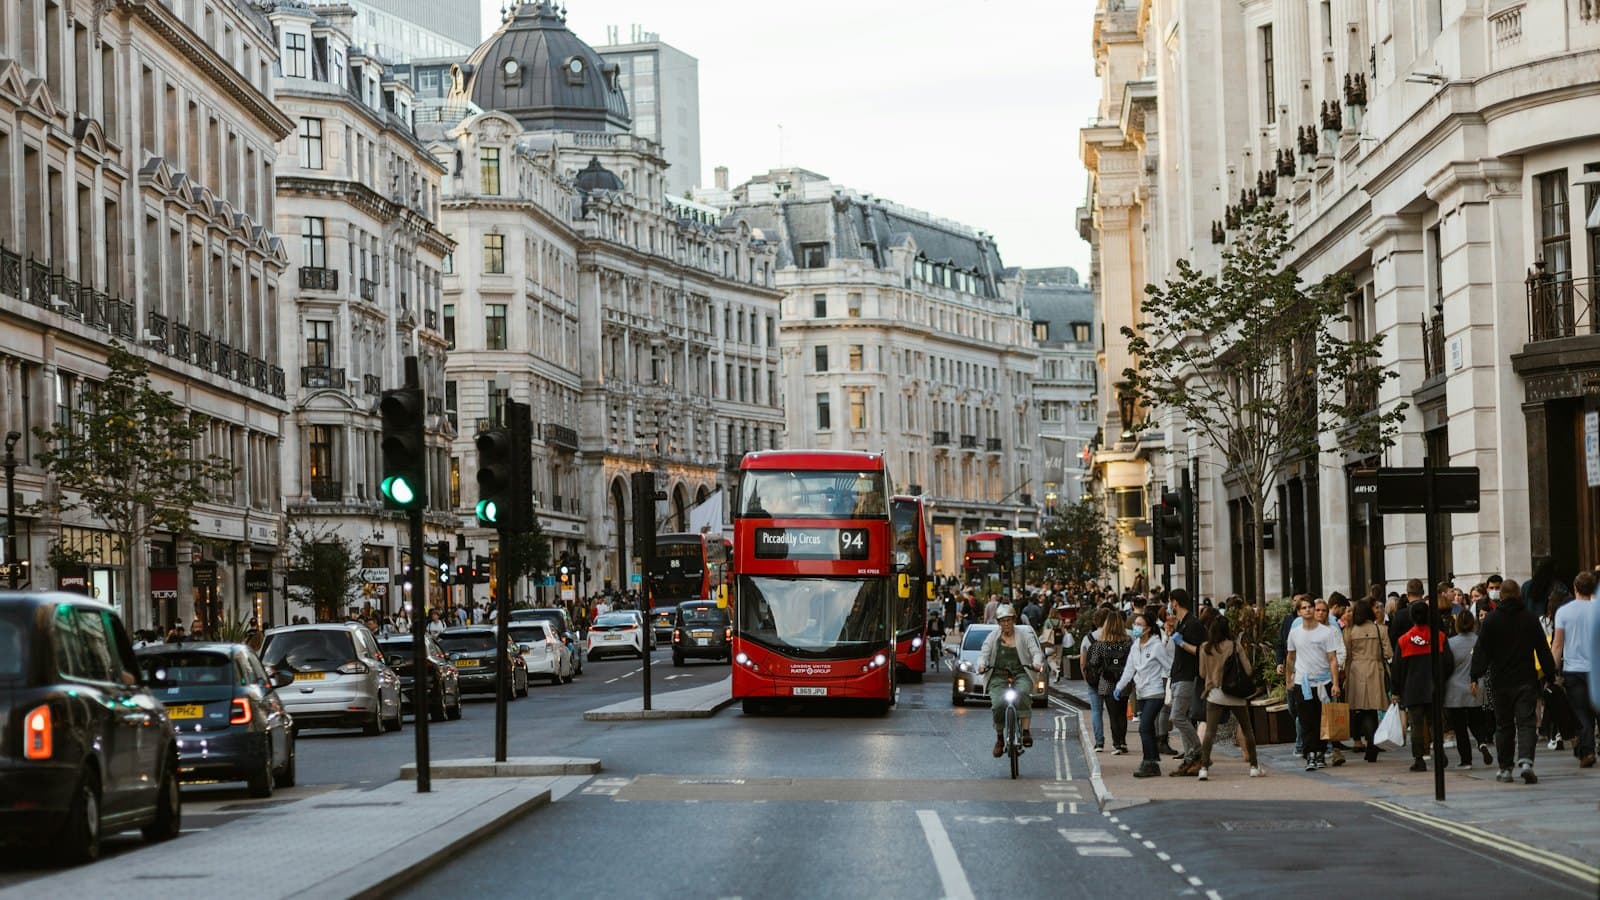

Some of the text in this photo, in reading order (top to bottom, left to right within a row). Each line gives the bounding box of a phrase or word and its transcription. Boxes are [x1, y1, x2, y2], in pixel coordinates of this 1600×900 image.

[763, 532, 821, 547] Piccadilly Circus
[841, 532, 864, 549] 94
[670, 559, 680, 568] 88
